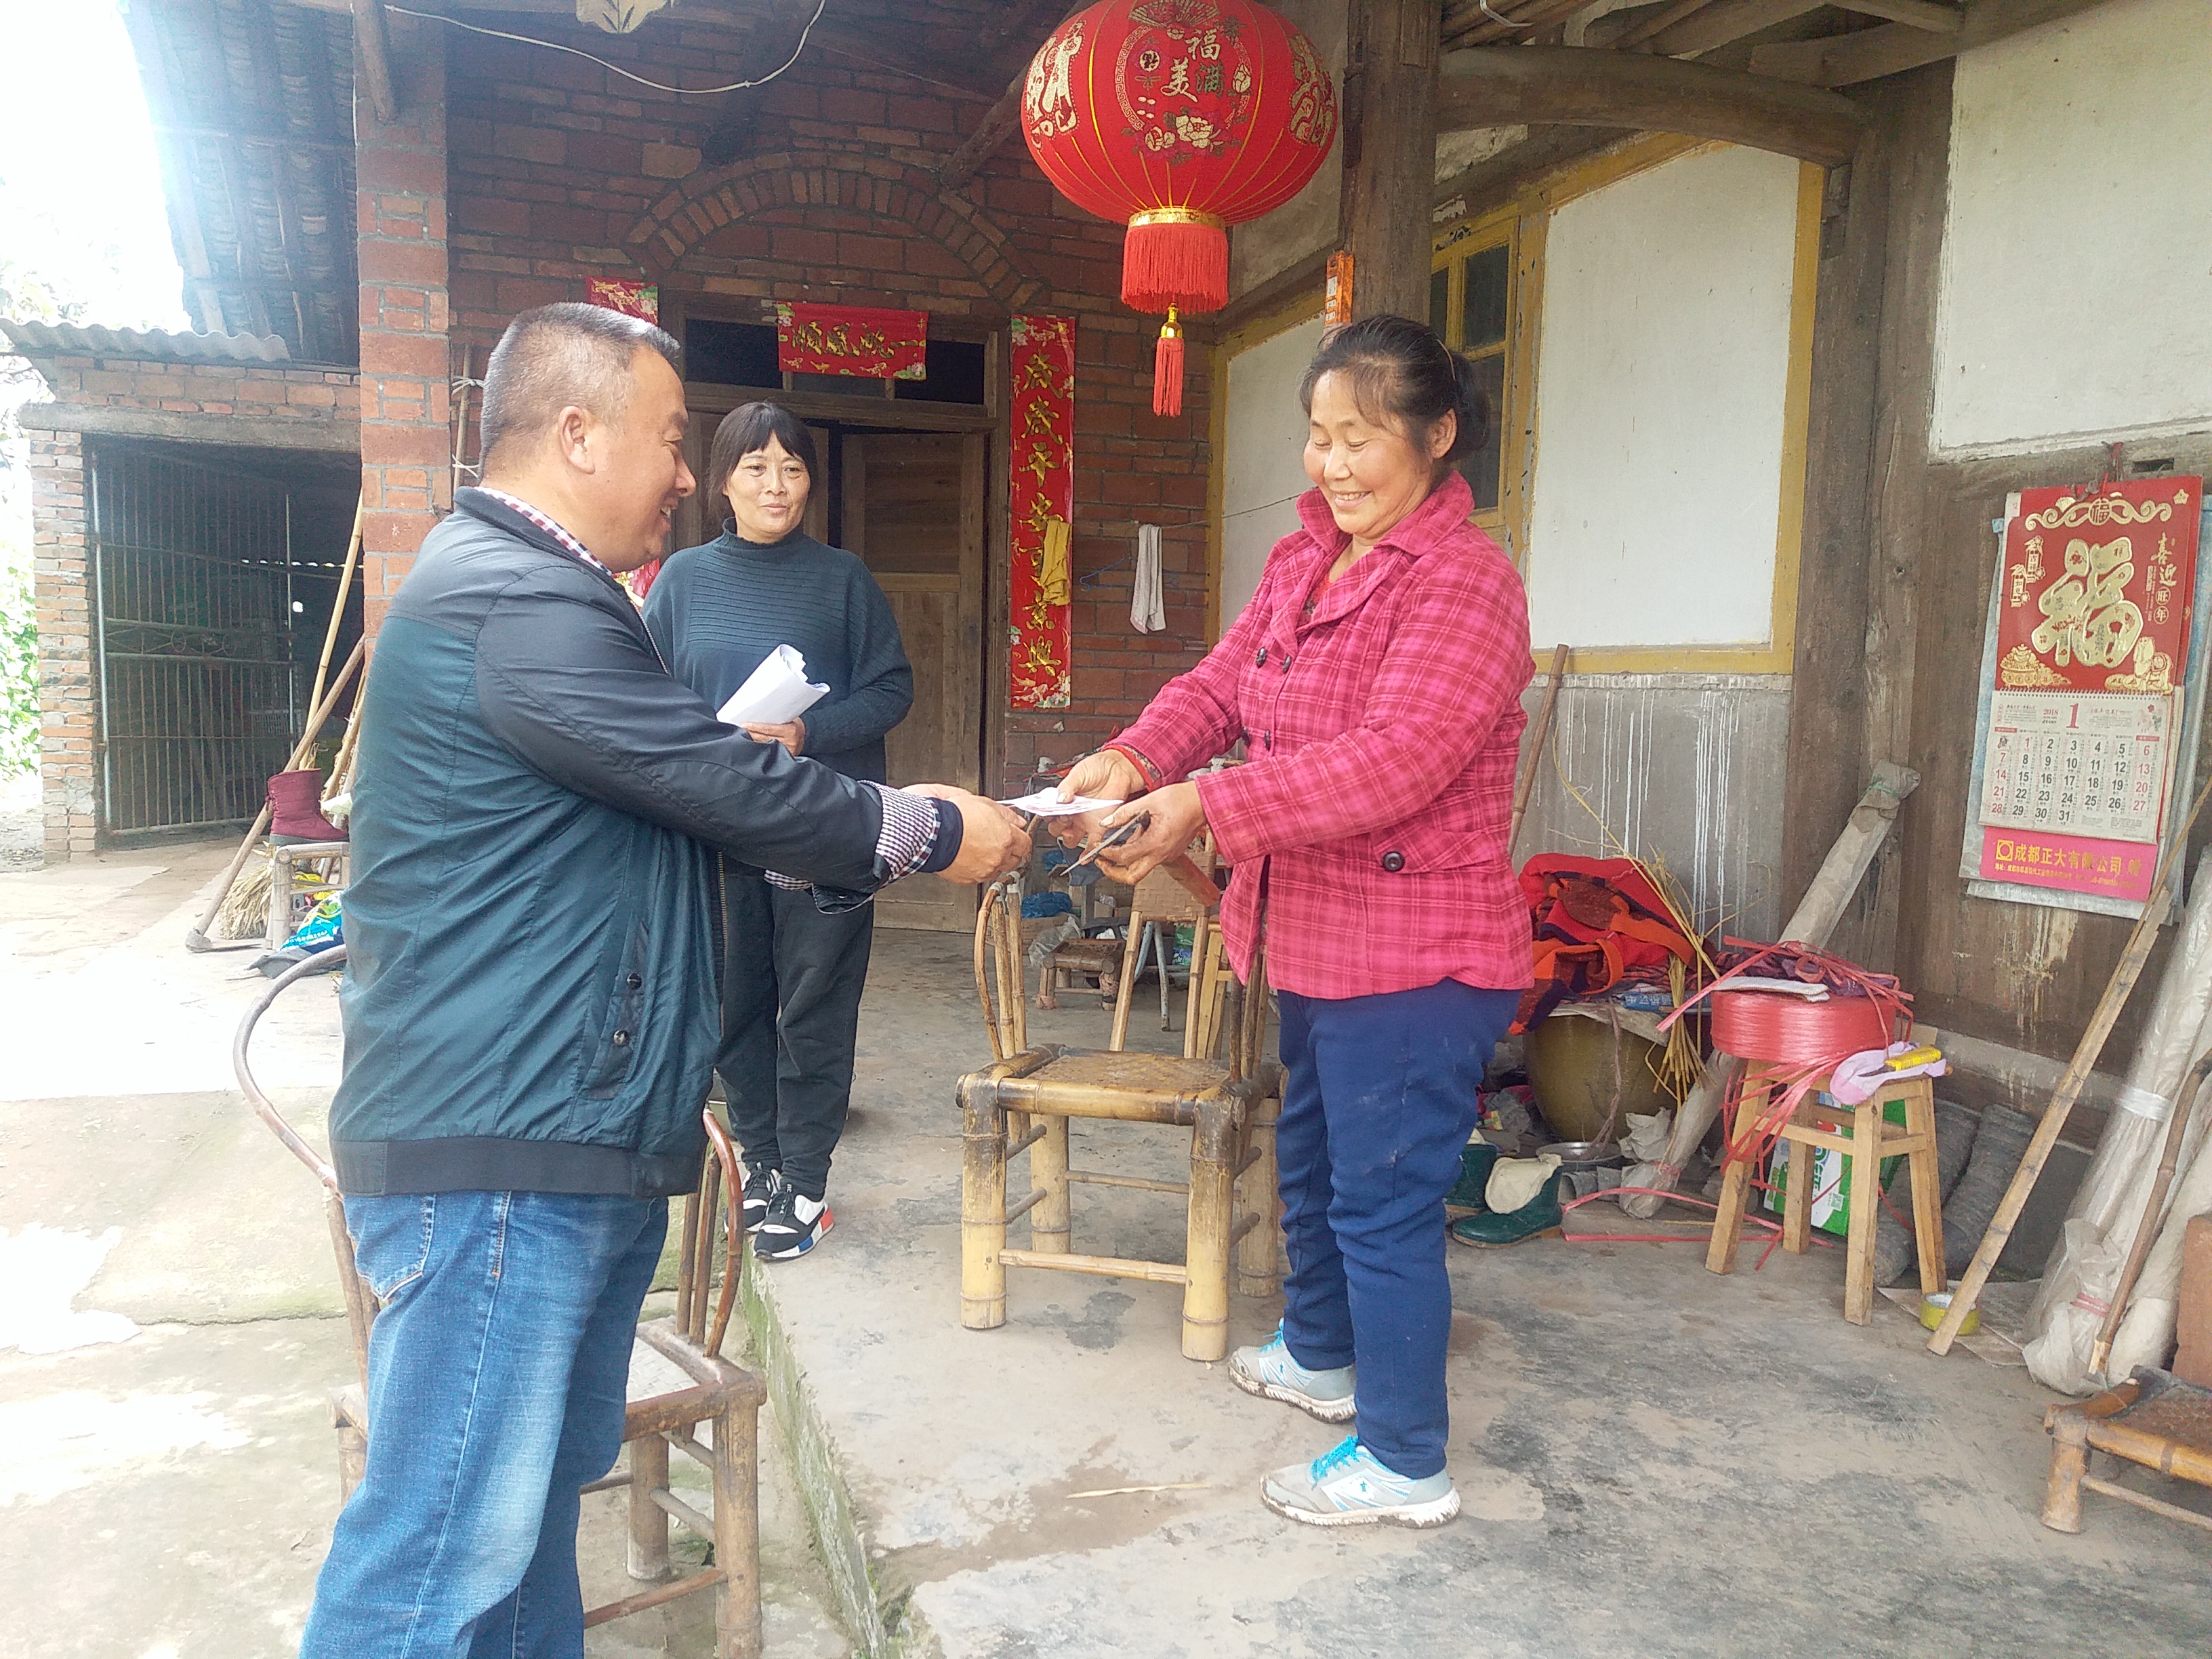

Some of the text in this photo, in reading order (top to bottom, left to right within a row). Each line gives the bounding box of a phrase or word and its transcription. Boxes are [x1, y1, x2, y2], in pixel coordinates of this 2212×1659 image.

[2090, 499, 2111, 525] 福
[2032, 536, 2144, 668] 福
[2066, 703, 2079, 729] 1
[2026, 737, 2149, 756] 1 2 3 4 5 6
[2001, 752, 2150, 775] 7 8 9 10 11 12 13
[1996, 770, 2148, 793] 14 15 16 17 18 19 20
[1994, 786, 2146, 811] 21 22 23 24 25 26 27
[1992, 803, 2070, 821] 28 29 30 31
[2014, 843, 2121, 876] 成都正大有限公司
